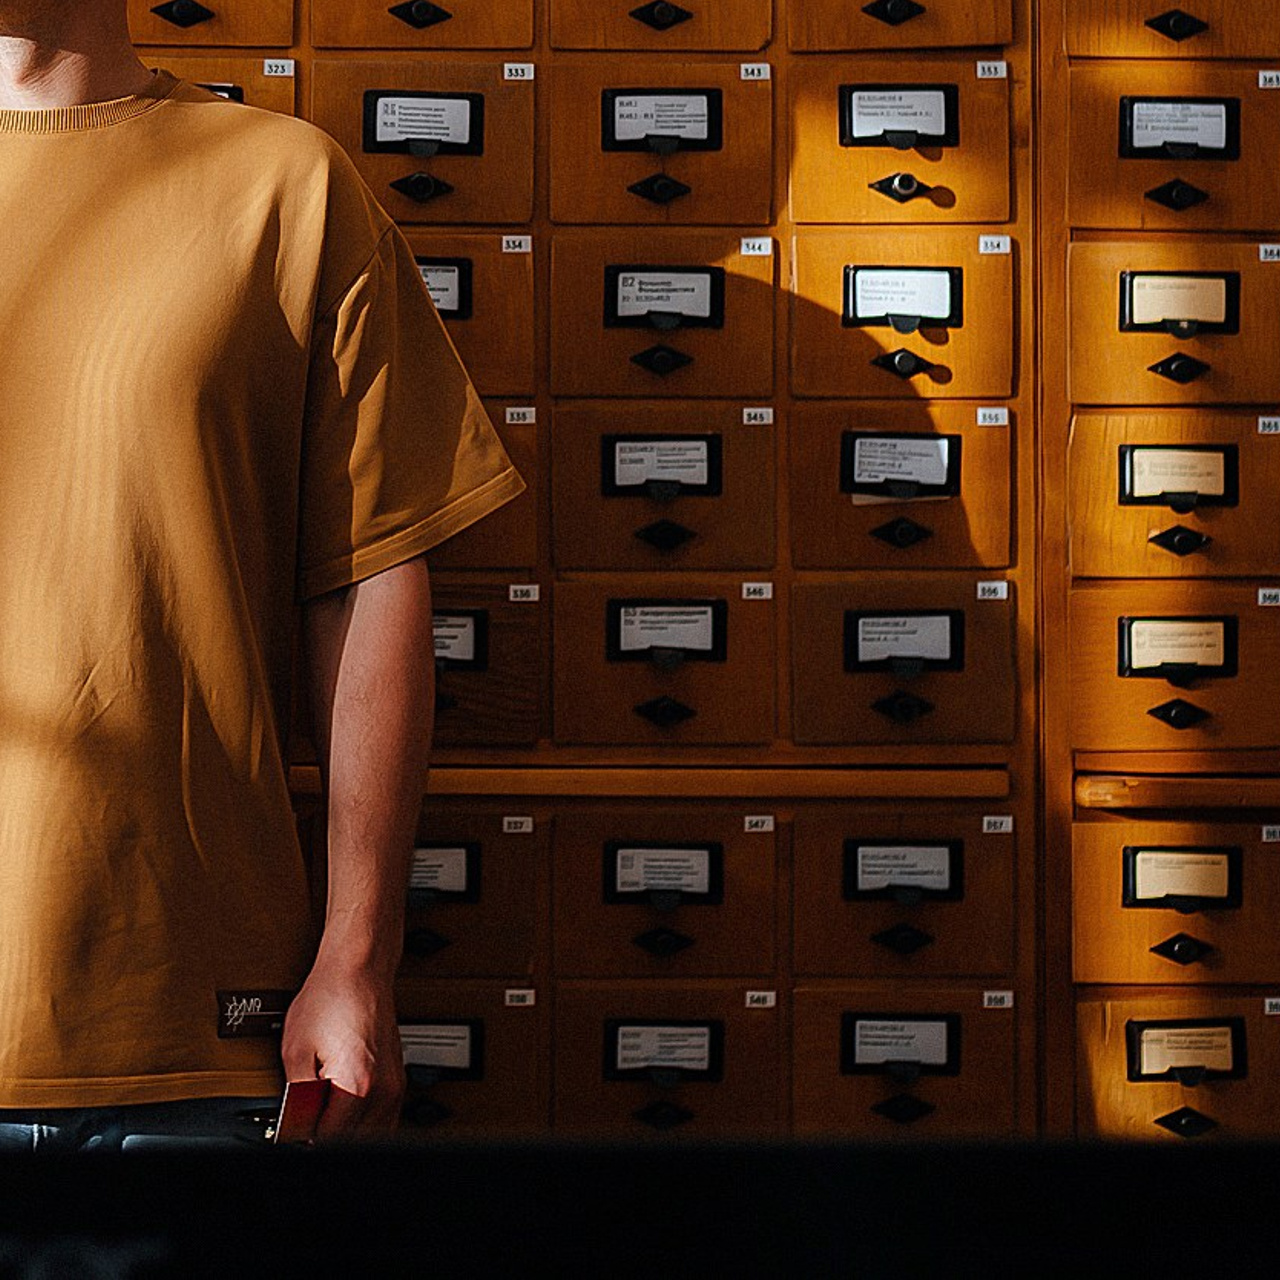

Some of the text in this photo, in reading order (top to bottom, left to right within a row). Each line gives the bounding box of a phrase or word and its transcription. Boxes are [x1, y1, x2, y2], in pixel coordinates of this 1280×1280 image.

[267, 63, 286, 74] 323
[507, 67, 526, 78] 333
[744, 67, 762, 77] 343
[504, 239, 523, 250] 334
[744, 241, 762, 252] 344
